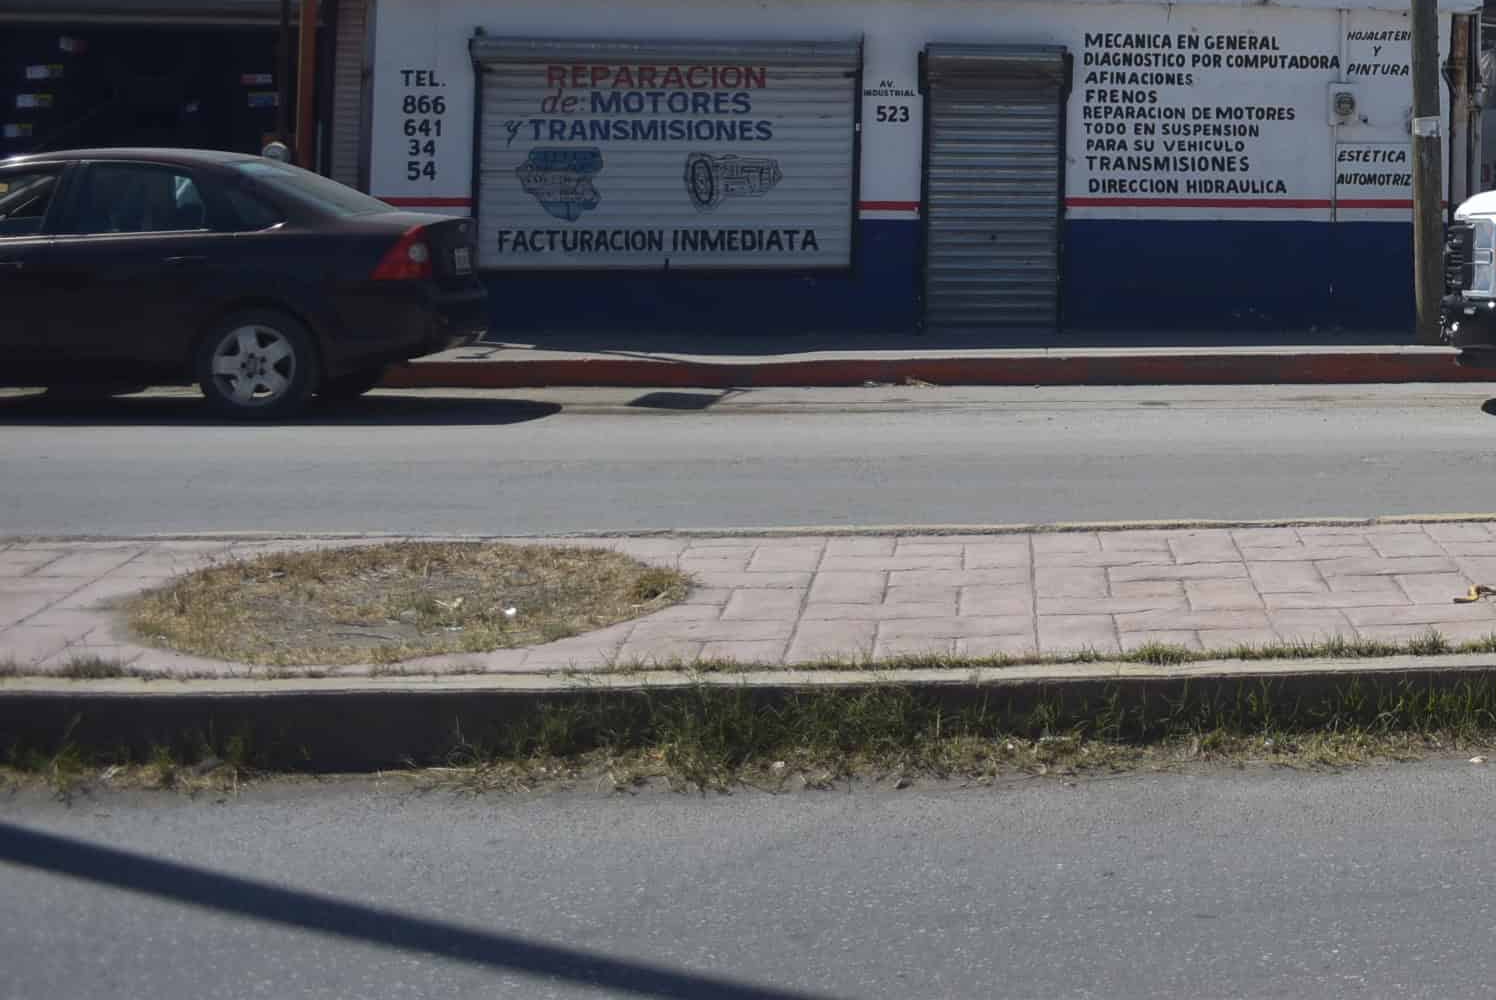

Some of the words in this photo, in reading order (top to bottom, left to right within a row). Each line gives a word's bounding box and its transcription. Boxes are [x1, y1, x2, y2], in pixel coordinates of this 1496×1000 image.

[1085, 33, 1172, 48] MECANICA
[1177, 35, 1199, 49] EN
[1204, 35, 1279, 50] GENERAL
[1347, 31, 1411, 41] HOJALATERI
[1373, 46, 1381, 56] Y
[1084, 53, 1185, 67] DIAGNOSTICO
[1191, 54, 1222, 67] POR
[1226, 54, 1340, 69] COMPUTADORA
[546, 66, 767, 88] REPARACION
[1347, 63, 1408, 76] PINTURA
[401, 70, 446, 88] TEL.
[880, 80, 895, 88] AV.
[1085, 71, 1193, 85] AFINACIONES
[590, 92, 751, 114] MOTORES
[1085, 89, 1158, 104] FRENOS
[402, 95, 446, 115] 866
[1083, 105, 1185, 120] REPARACION
[1191, 106, 1212, 120] DE
[1215, 106, 1296, 121] MOTORES
[876, 106, 909, 122] 523
[403, 118, 442, 137] 641
[529, 119, 772, 141] TRANSMISIONES
[1084, 123, 1127, 136] TODO
[1134, 124, 1155, 136] EN
[1161, 123, 1259, 137] SUSPENSION
[408, 139, 436, 157] 34
[1086, 139, 1128, 152] PARA
[1134, 139, 1154, 152] SU
[1164, 140, 1245, 153] VEHICULO
[406, 161, 436, 181] 54
[1085, 156, 1249, 172] TRANSMISIONES
[1088, 179, 1179, 193] DIRECCION
[1186, 179, 1287, 194] HIDRAULICA
[1337, 174, 1412, 185] AUTOMOTRIZ
[498, 230, 662, 252] FACTURACION
[672, 230, 818, 251] INMEDIATA
